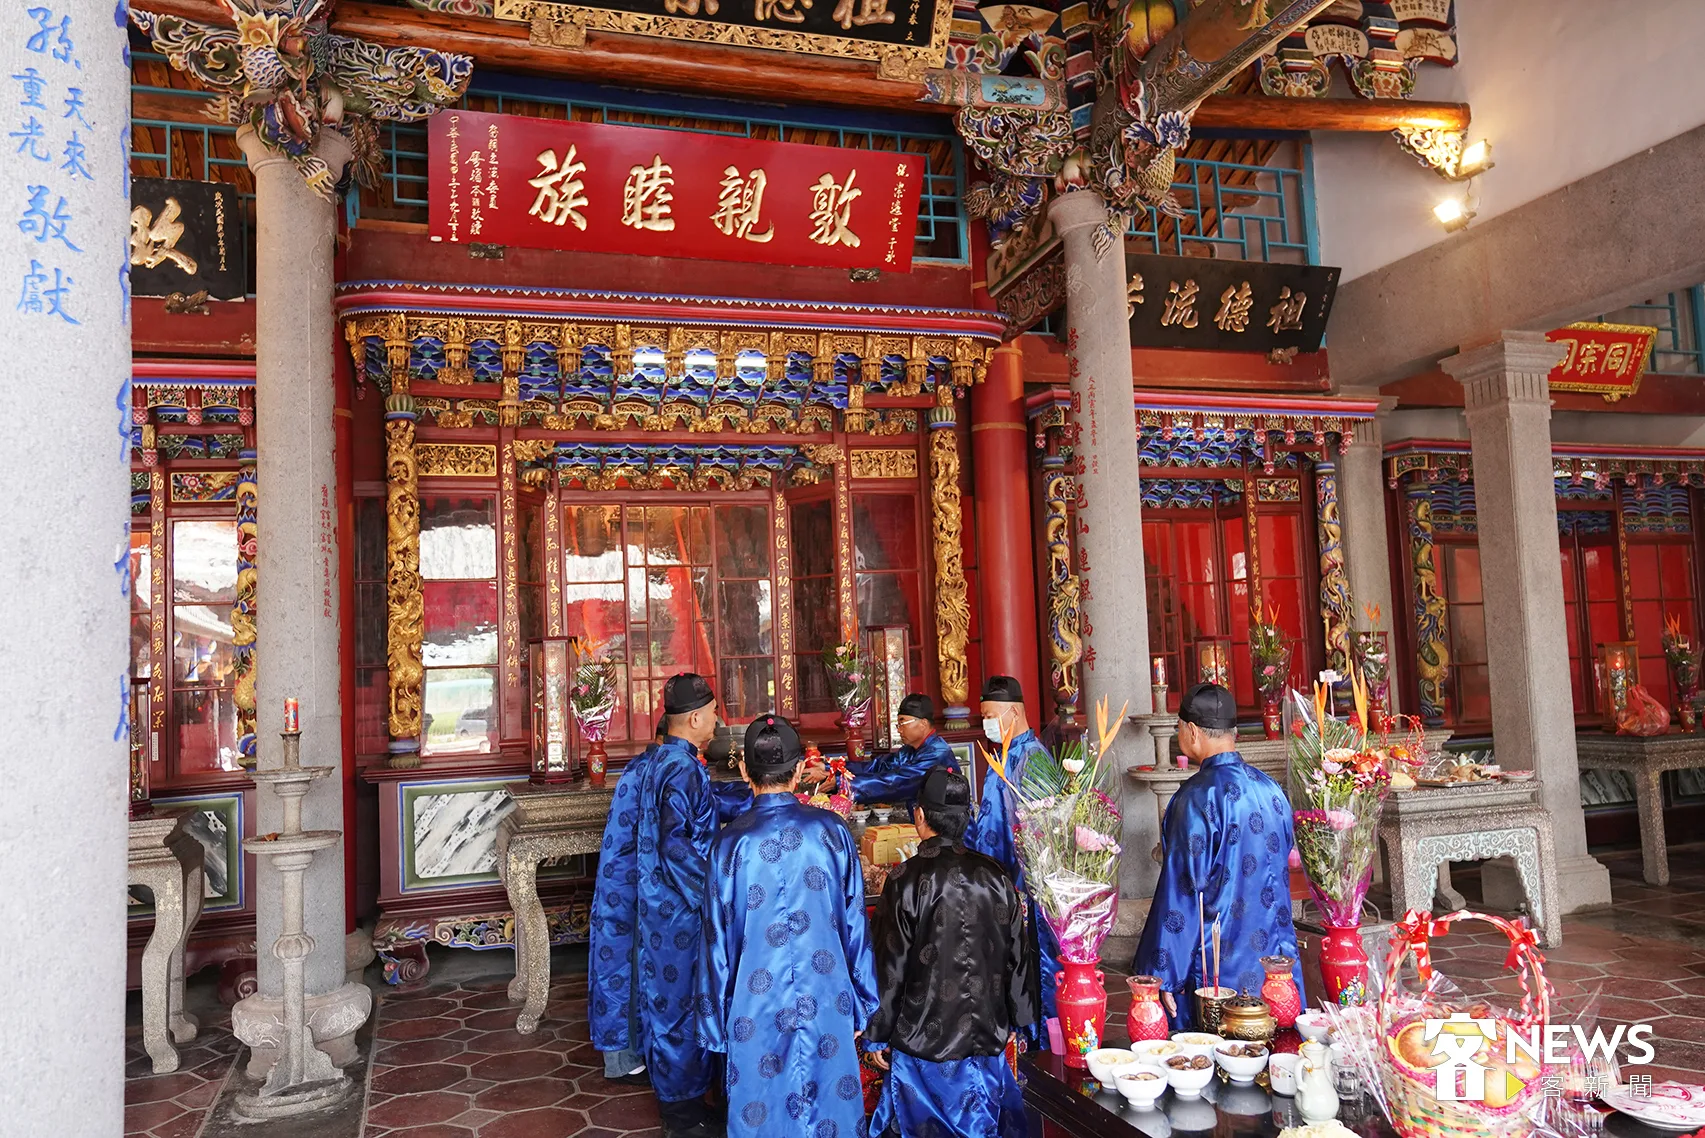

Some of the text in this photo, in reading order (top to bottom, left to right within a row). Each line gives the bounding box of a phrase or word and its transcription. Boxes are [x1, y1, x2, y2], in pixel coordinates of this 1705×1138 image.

[9, 67, 51, 162] 重光
[527, 144, 863, 250] 敦親睦族
